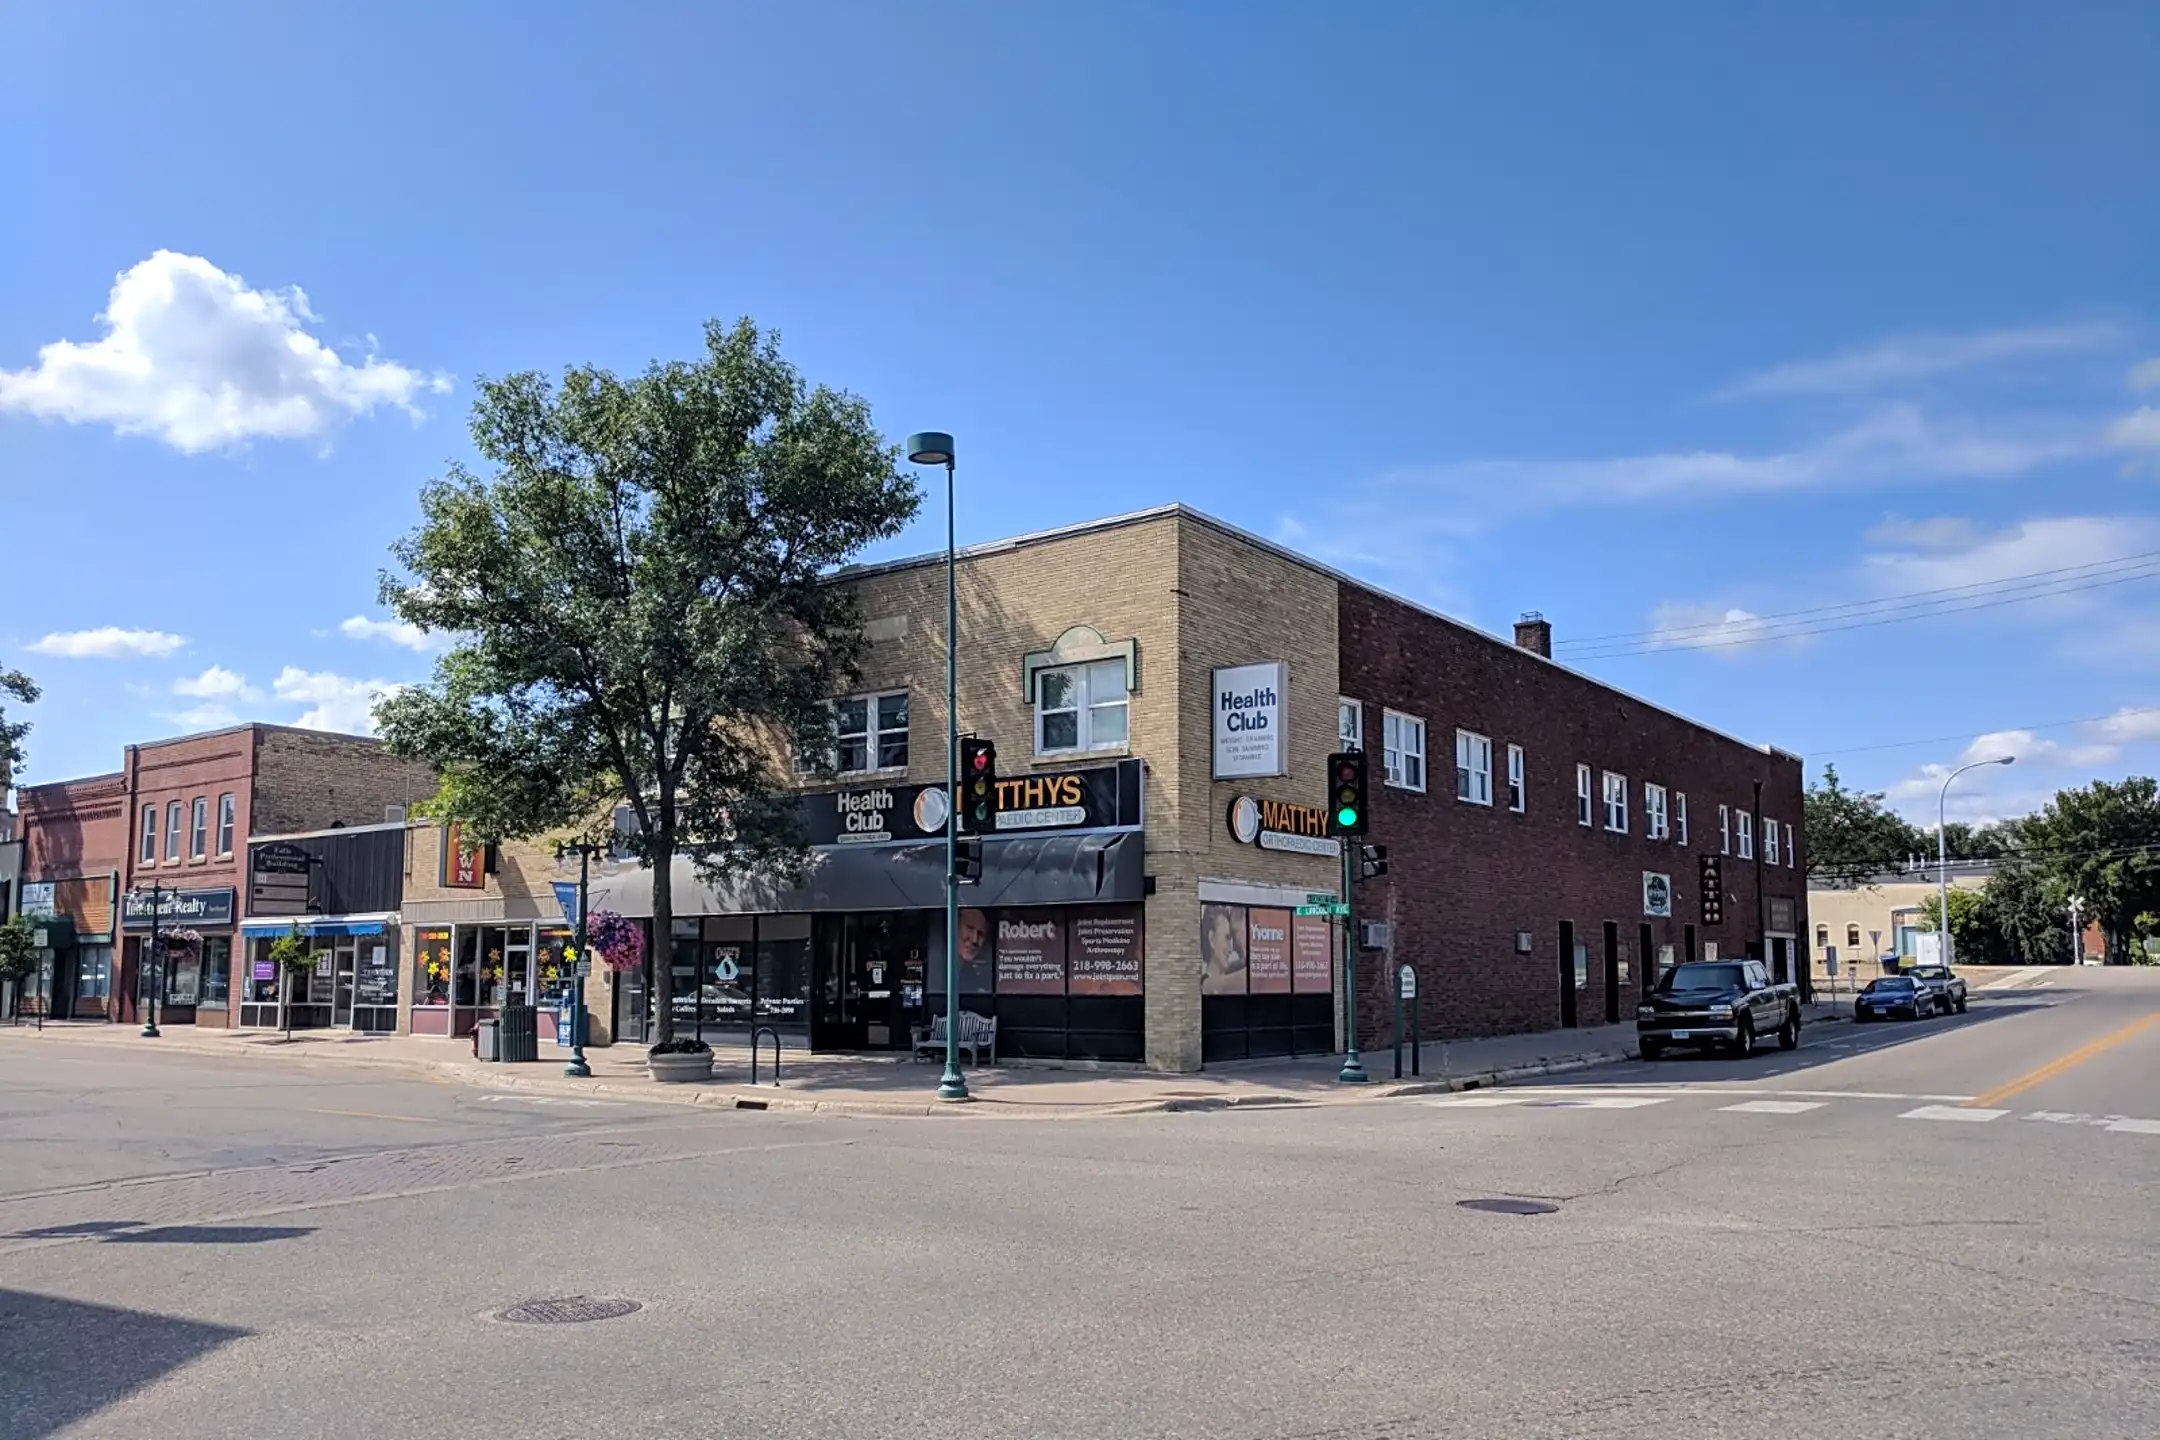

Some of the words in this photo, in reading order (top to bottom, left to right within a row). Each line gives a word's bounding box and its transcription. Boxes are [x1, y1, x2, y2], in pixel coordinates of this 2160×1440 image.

[1221, 687, 1276, 711] Health
[1227, 710, 1268, 732] Club
[837, 789, 893, 813] Health
[957, 776, 1081, 812] TTHYS
[846, 811, 884, 832] Club
[1036, 810, 1081, 824] CENTER
[1263, 800, 1330, 836] MATTHY
[1313, 841, 1337, 853] CENTER
[459, 855, 474, 882] WN
[1702, 857, 1720, 922] TATTOO
[176, 898, 206, 917] Realty
[998, 920, 1055, 939] Robert
[1250, 923, 1284, 941] Yvonne
[1081, 937, 1101, 946] Sports
[1026, 963, 1061, 972] everything
[1073, 960, 1138, 971] 218-998-2663
[999, 972, 1013, 982] just
[1024, 971, 1033, 979] fix
[717, 1006, 735, 1014] Salads
[760, 997, 781, 1006] Private
[782, 997, 804, 1005] Parties
